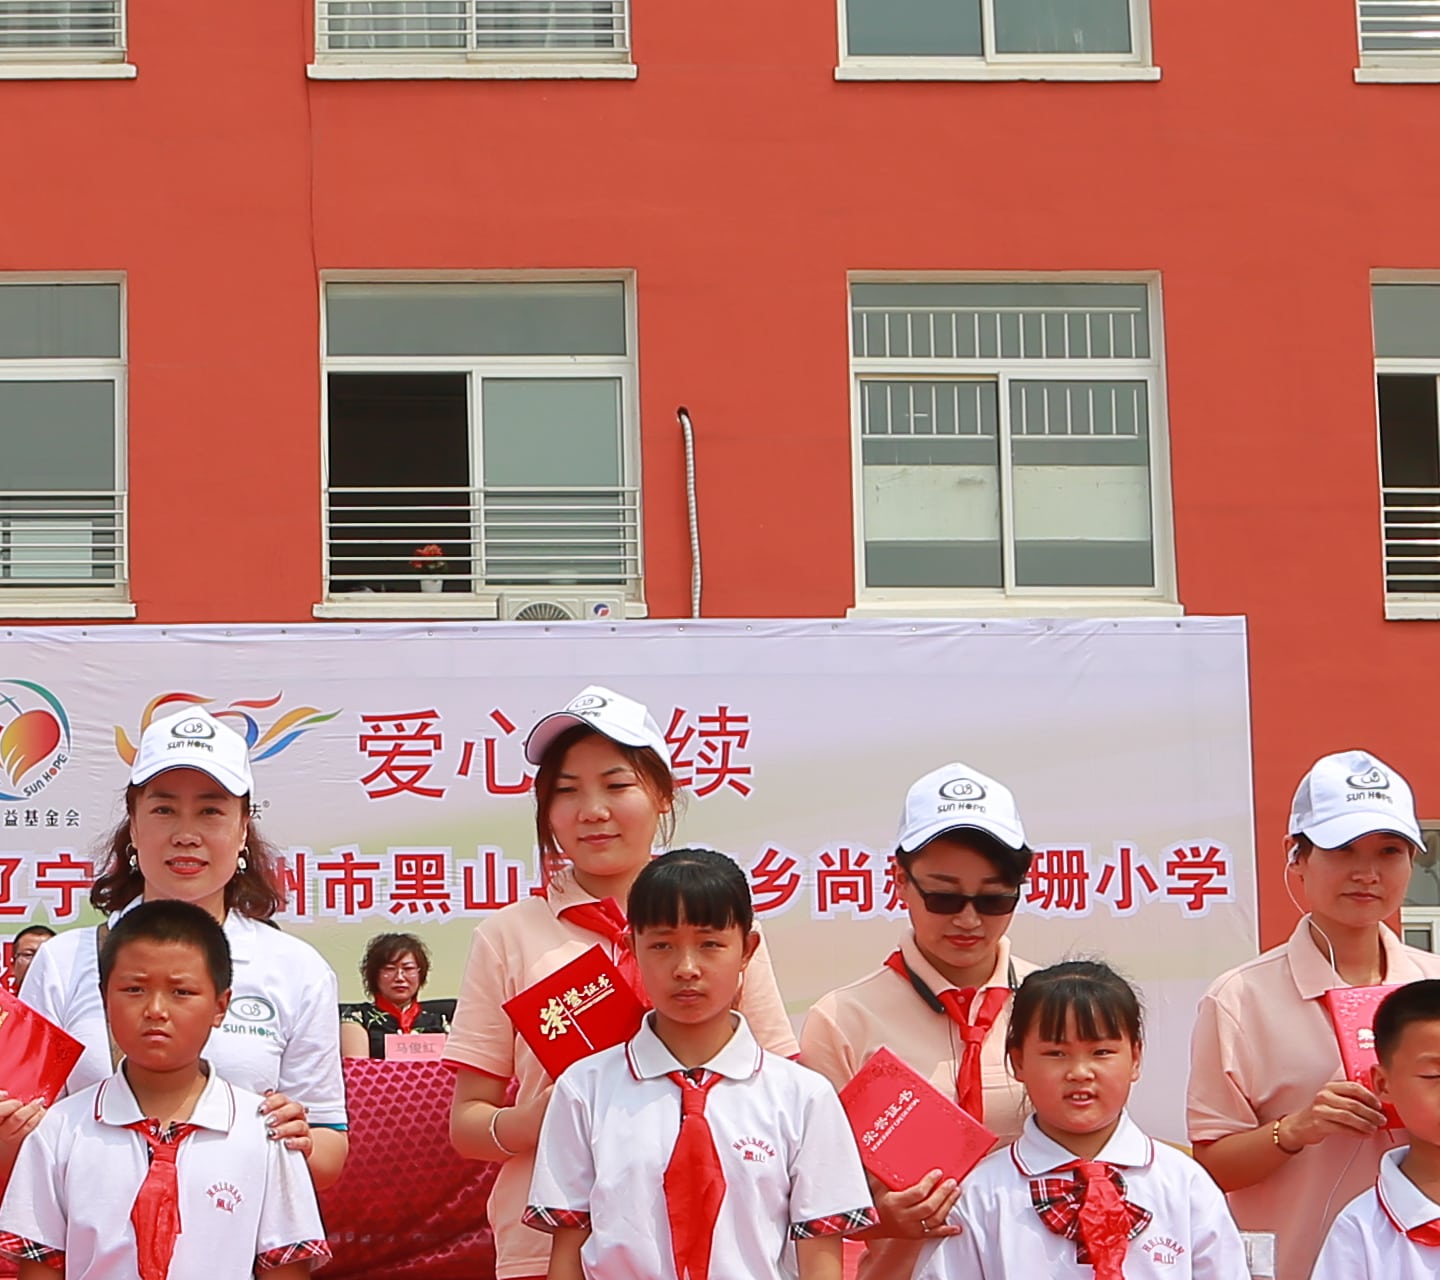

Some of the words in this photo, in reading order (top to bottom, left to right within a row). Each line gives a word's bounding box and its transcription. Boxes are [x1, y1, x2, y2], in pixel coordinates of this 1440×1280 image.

[359, 705, 752, 799] 爱心续
[23, 780, 45, 797] SUN
[43, 753, 68, 783] HOPE
[222, 1023, 247, 1036] SUN
